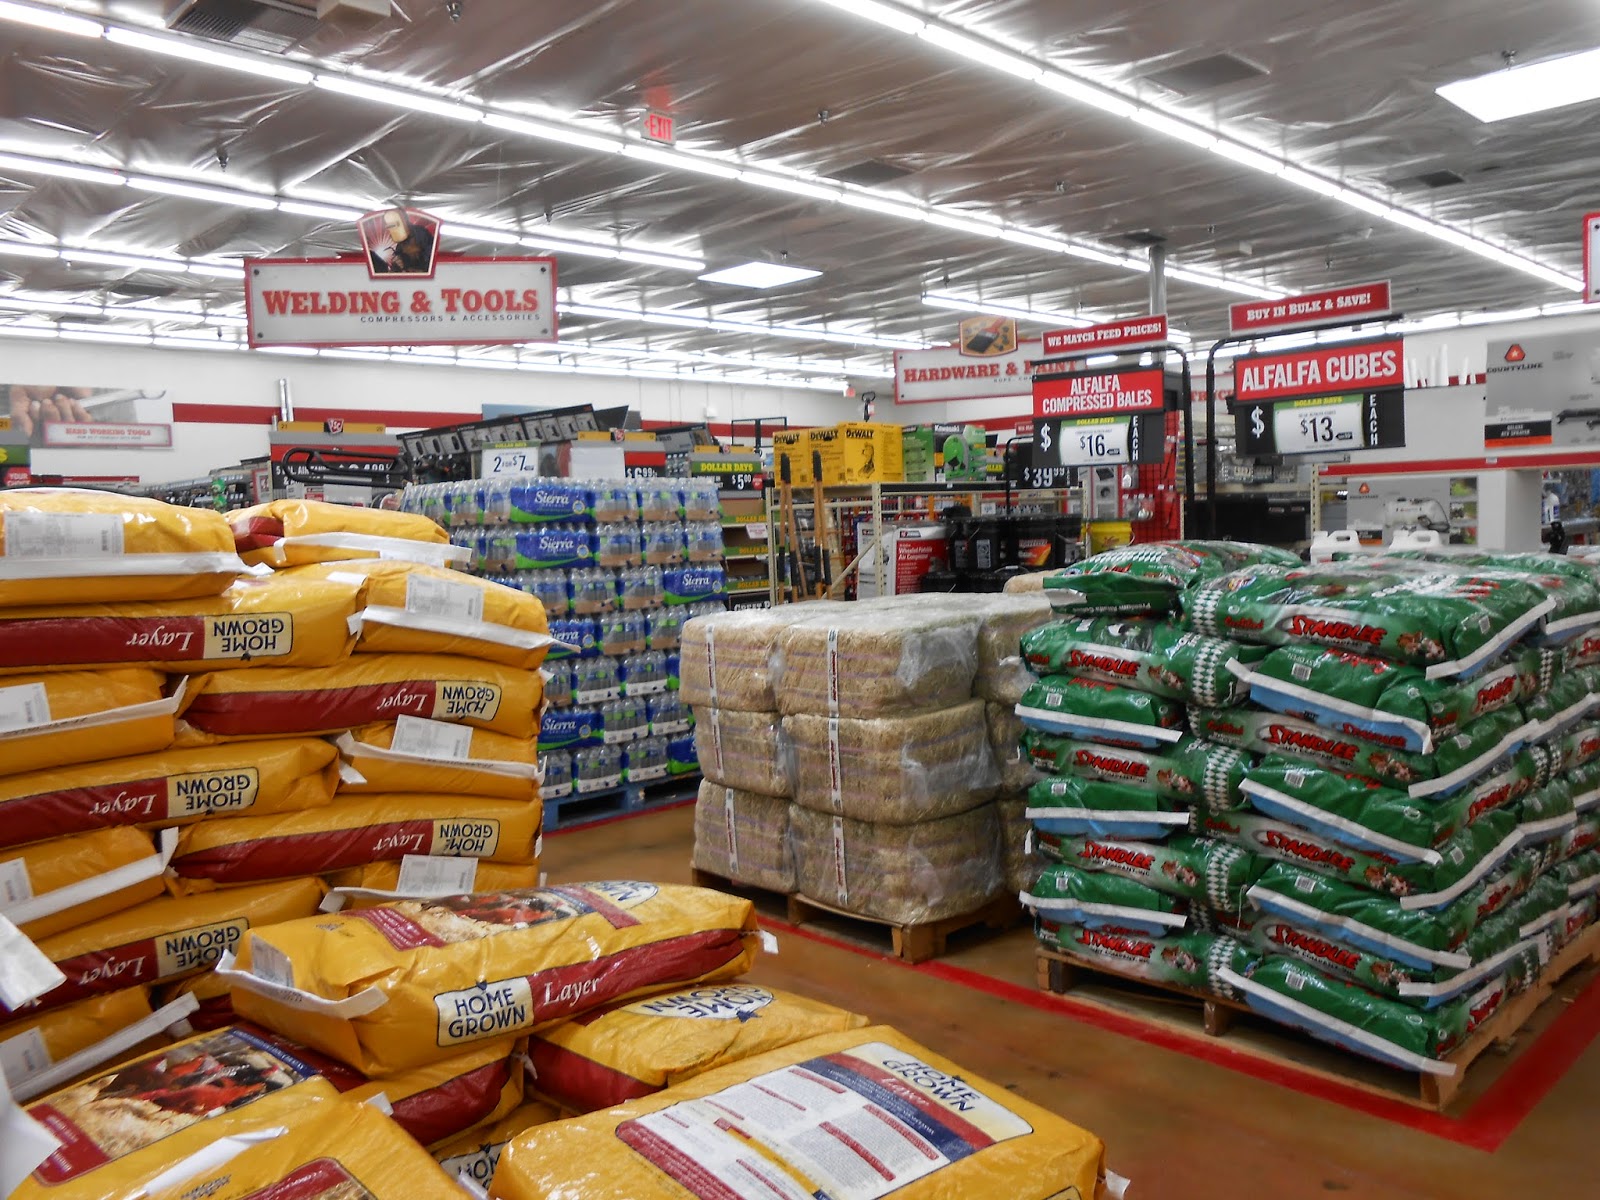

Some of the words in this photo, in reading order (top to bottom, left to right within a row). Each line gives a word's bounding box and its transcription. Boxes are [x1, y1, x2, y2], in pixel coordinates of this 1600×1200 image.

[649, 113, 673, 142] EXIT
[262, 289, 400, 316] WELDING
[410, 290, 431, 313] &
[441, 288, 538, 313] TOOLS
[1247, 307, 1270, 321] BUY
[1273, 305, 1286, 317] IN
[1289, 300, 1321, 314] BULK
[1324, 298, 1334, 310] &
[1337, 293, 1371, 308] SAVE!
[360, 314, 443, 323] COMPRESSORS
[462, 313, 540, 321] ACCESSORIES
[1048, 336, 1062, 347] WE
[1063, 332, 1095, 345] MATCH
[1097, 328, 1122, 340] FEED
[1123, 322, 1162, 337] PRICES!
[904, 363, 999, 383] HARDWARE
[1005, 361, 1018, 376] &
[1240, 359, 1321, 392] ALFALFA
[1326, 350, 1397, 383] CUBES
[1486, 362, 1543, 374] COUNTYLINE
[1070, 374, 1121, 396] ALFALFA
[1042, 393, 1114, 414] COMPRESSED
[1116, 389, 1152, 410] BALES
[1293, 398, 1322, 408] DOLLAR
[1323, 395, 1344, 405] DAYS
[89, 428, 126, 436] WORKING
[1076, 418, 1099, 426] DOLLAR
[1100, 416, 1115, 424] DAYS
[1251, 405, 1266, 439] $
[1300, 416, 1334, 443] $13
[1369, 394, 1379, 446] EACH
[1040, 422, 1052, 452] $
[1080, 434, 1106, 457] $16
[493, 456, 502, 472] 2
[512, 455, 527, 471] $7
[701, 462, 732, 472] DOLLAR
[734, 463, 754, 472] DAYS
[534, 490, 569, 505] Sierra
[539, 537, 574, 550] Sierra
[682, 573, 710, 586] Sierra
[126, 626, 194, 652] Layer
[213, 618, 284, 637] GROWN
[1288, 615, 1387, 645] STANDLEE
[222, 635, 276, 652] HOME
[1066, 649, 1141, 676] STANDLEE
[376, 688, 428, 711] Layer
[442, 686, 495, 701] GROWN
[446, 700, 486, 715] HOME
[542, 717, 577, 731] Sierra
[1264, 724, 1360, 761] STANDLEE
[1074, 750, 1150, 778] STANDLEE
[177, 774, 250, 796] GROWN
[89, 791, 157, 815] Layer
[186, 792, 242, 810] HOME
[372, 829, 425, 850] Layer
[440, 824, 493, 838] GROWN
[1077, 840, 1156, 870] STANDLEE
[1260, 830, 1355, 872] STANDLEE
[166, 925, 240, 955] GROWN
[1076, 929, 1156, 957] STANDLEE
[1268, 924, 1362, 970] STANDLEE
[78, 955, 145, 986] Layer
[454, 987, 514, 1015] HOME
[543, 976, 602, 1007] Layer
[678, 992, 773, 1018] HOME
[448, 1004, 526, 1038] GROWN
[883, 1060, 975, 1111] GROWN
[906, 1062, 981, 1101] HOME
[458, 1153, 500, 1179] HOM
